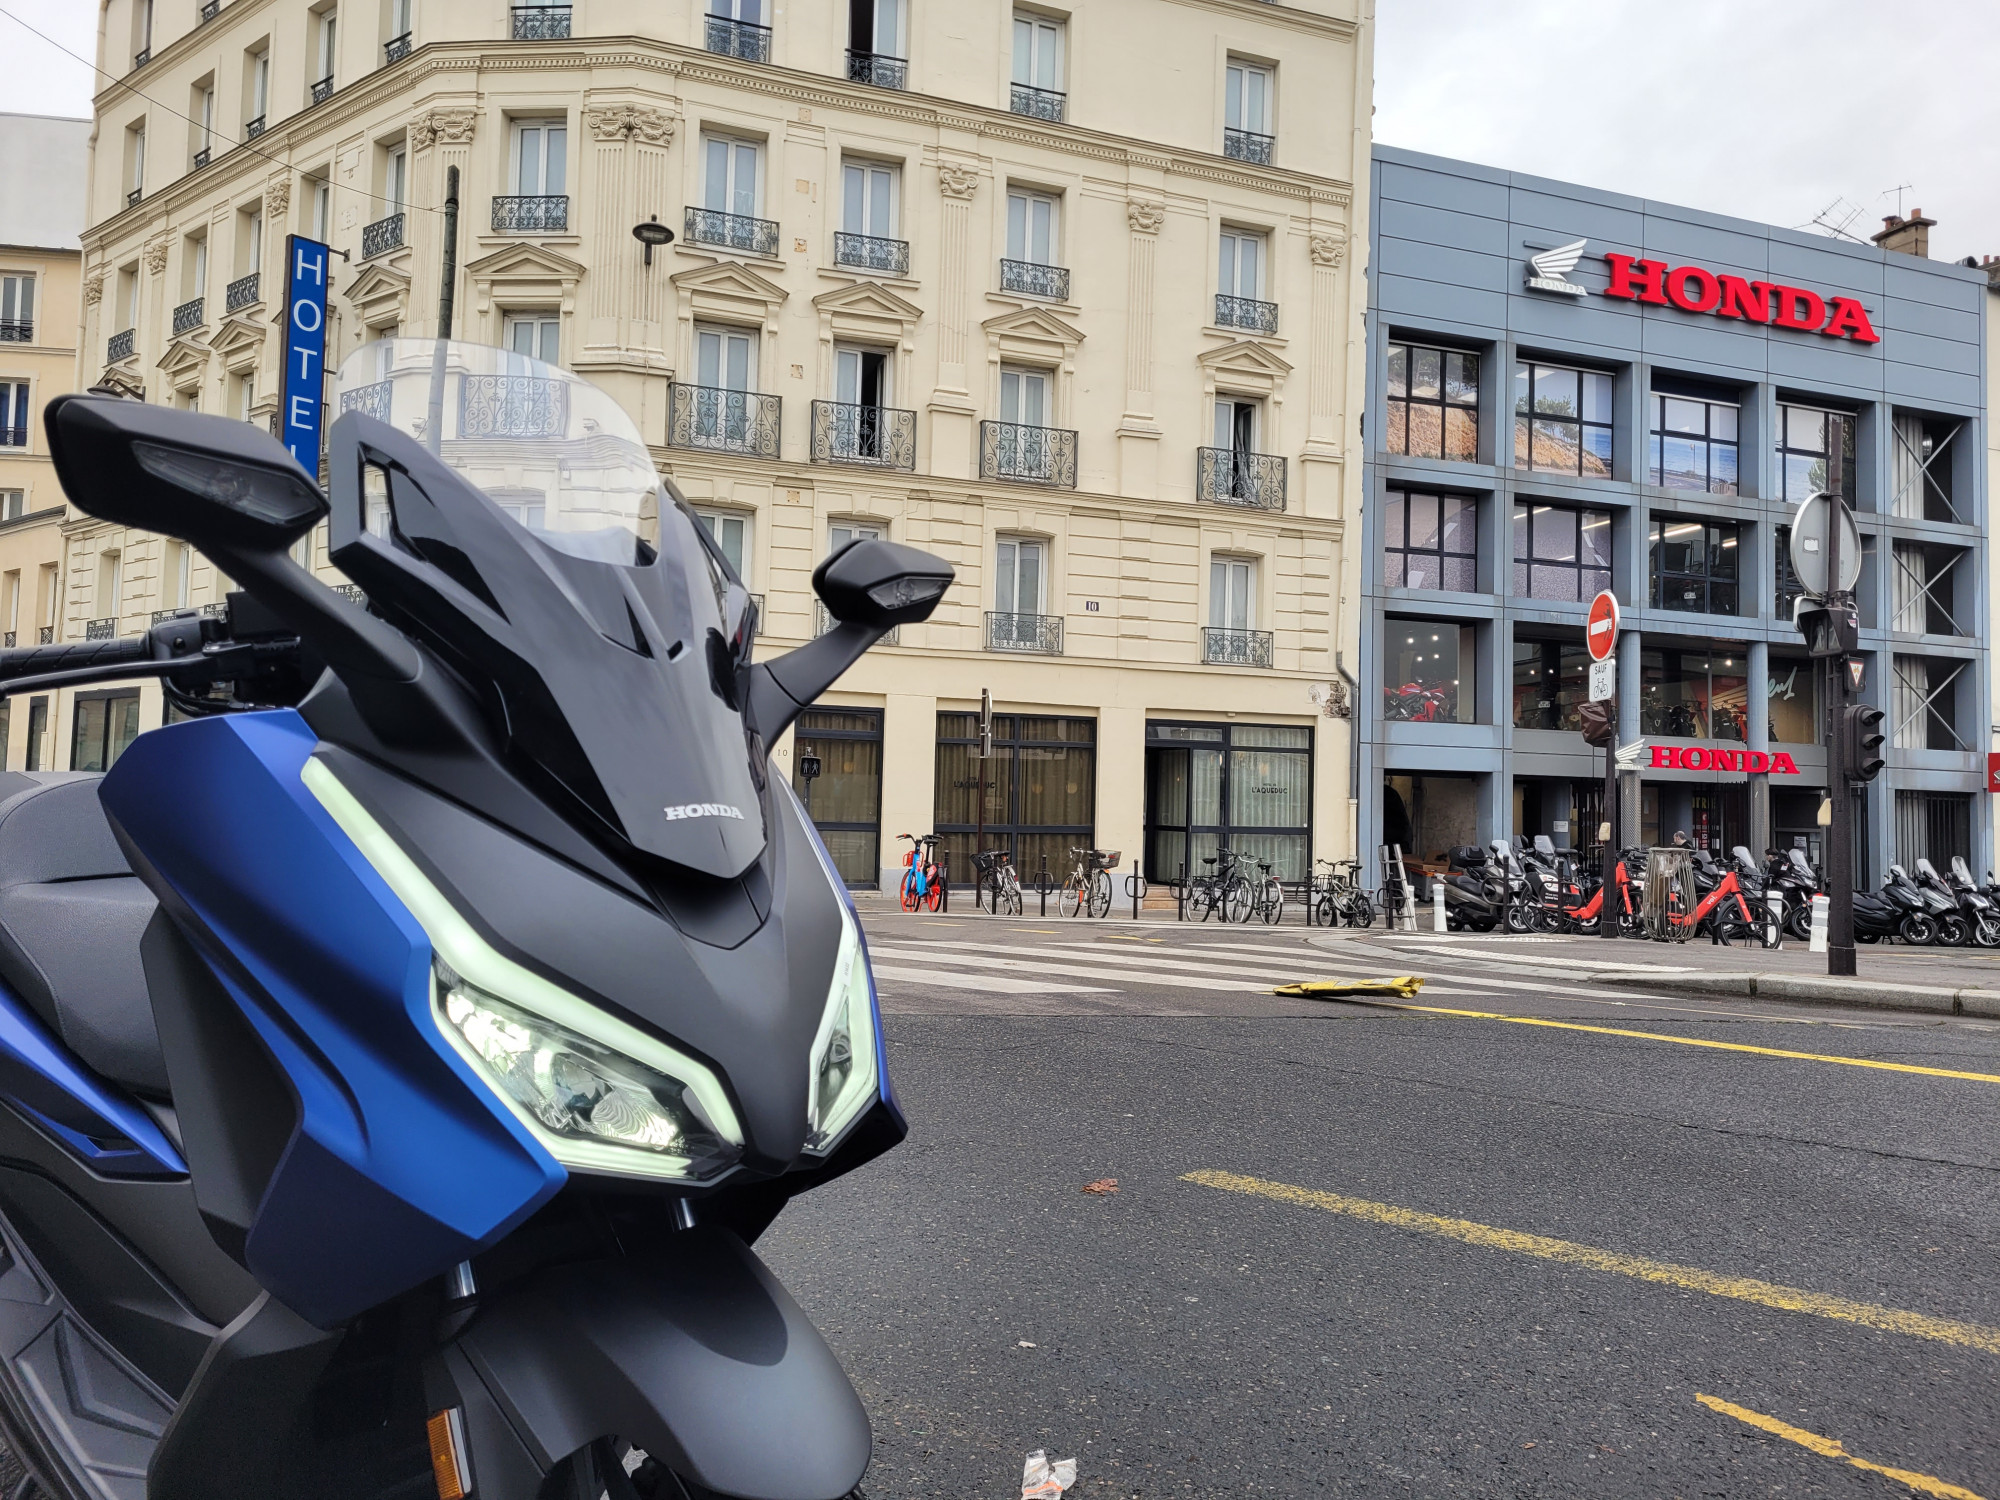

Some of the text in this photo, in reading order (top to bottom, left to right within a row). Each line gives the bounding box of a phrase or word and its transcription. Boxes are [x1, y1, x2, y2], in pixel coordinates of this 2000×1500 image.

[1529, 277, 1588, 296] HONDA
[1604, 252, 1880, 344] HONDA
[1087, 601, 1098, 611] 10
[1594, 663, 1607, 675] SAUF
[777, 749, 788, 757] 10
[1649, 746, 1800, 774] HONDA
[953, 781, 996, 789] L'AQUEUC
[664, 804, 744, 820] HONDA
